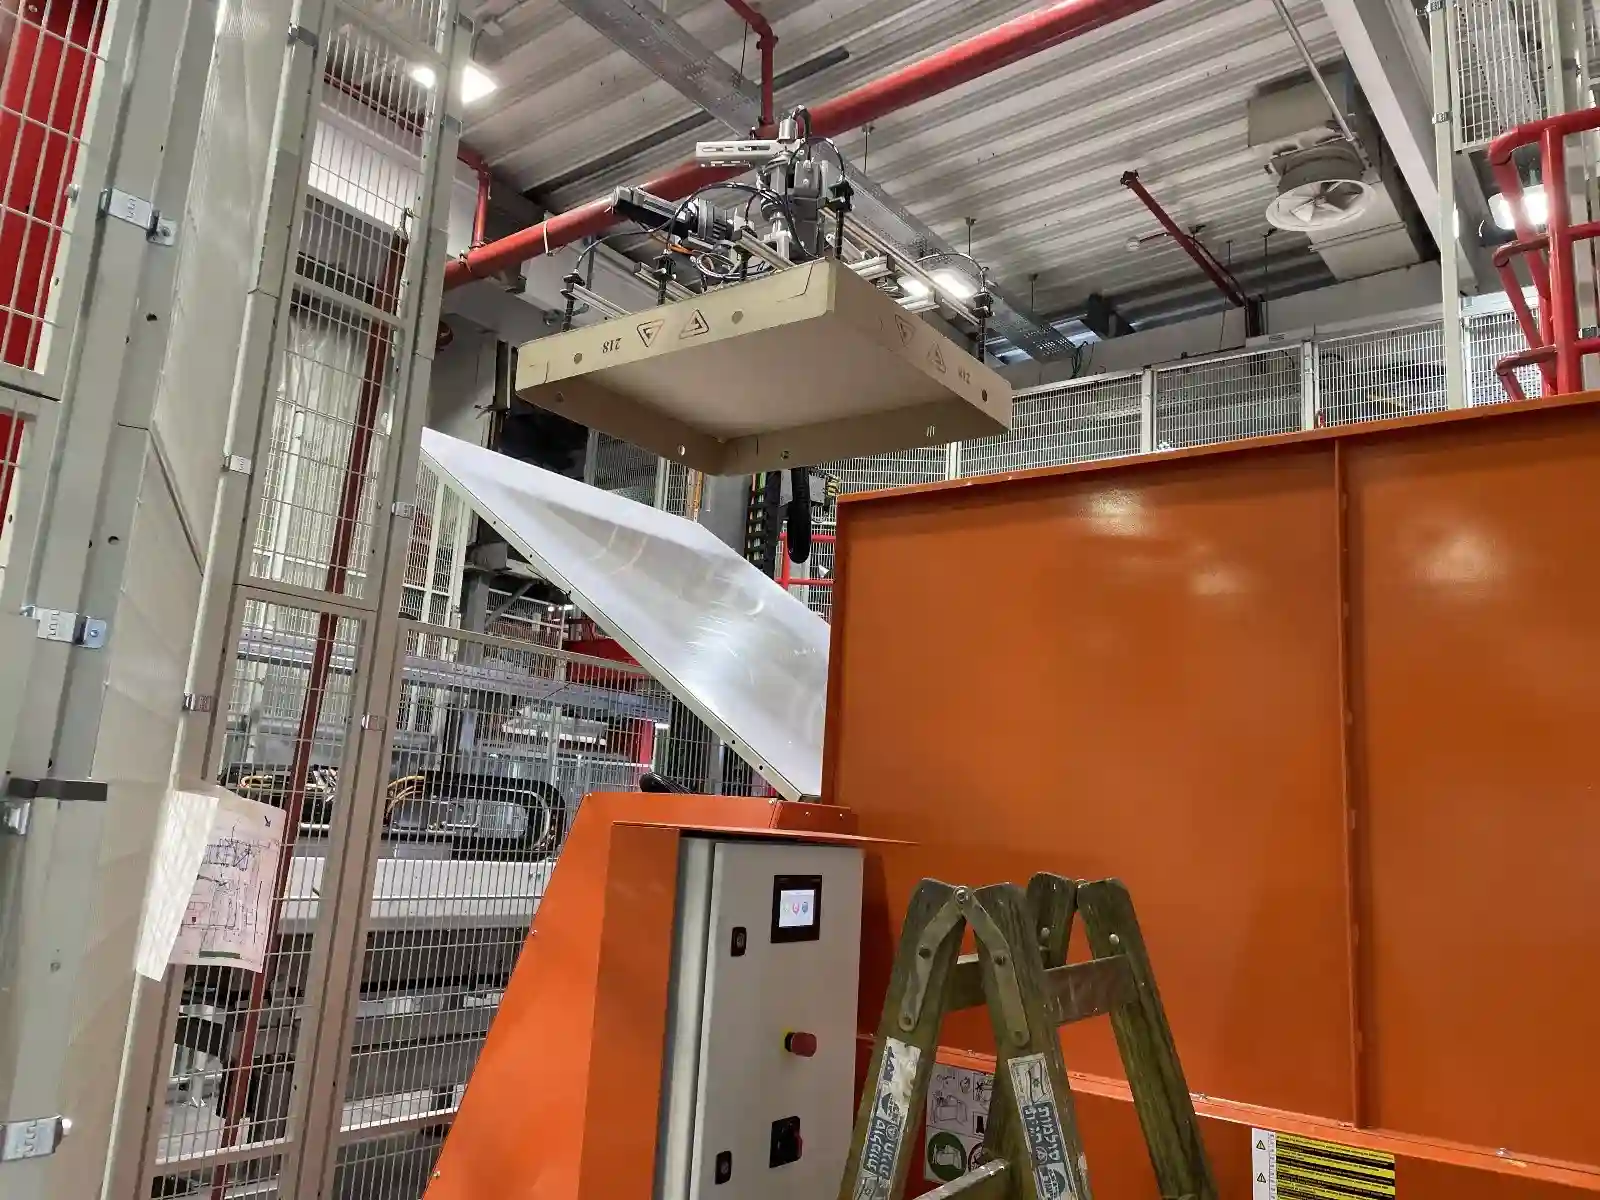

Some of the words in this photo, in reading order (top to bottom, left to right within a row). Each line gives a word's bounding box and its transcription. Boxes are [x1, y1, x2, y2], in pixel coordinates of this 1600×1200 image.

[602, 337, 622, 354] 218
[866, 1118, 886, 1173] סולמות
[1038, 1106, 1061, 1161] סולמות
